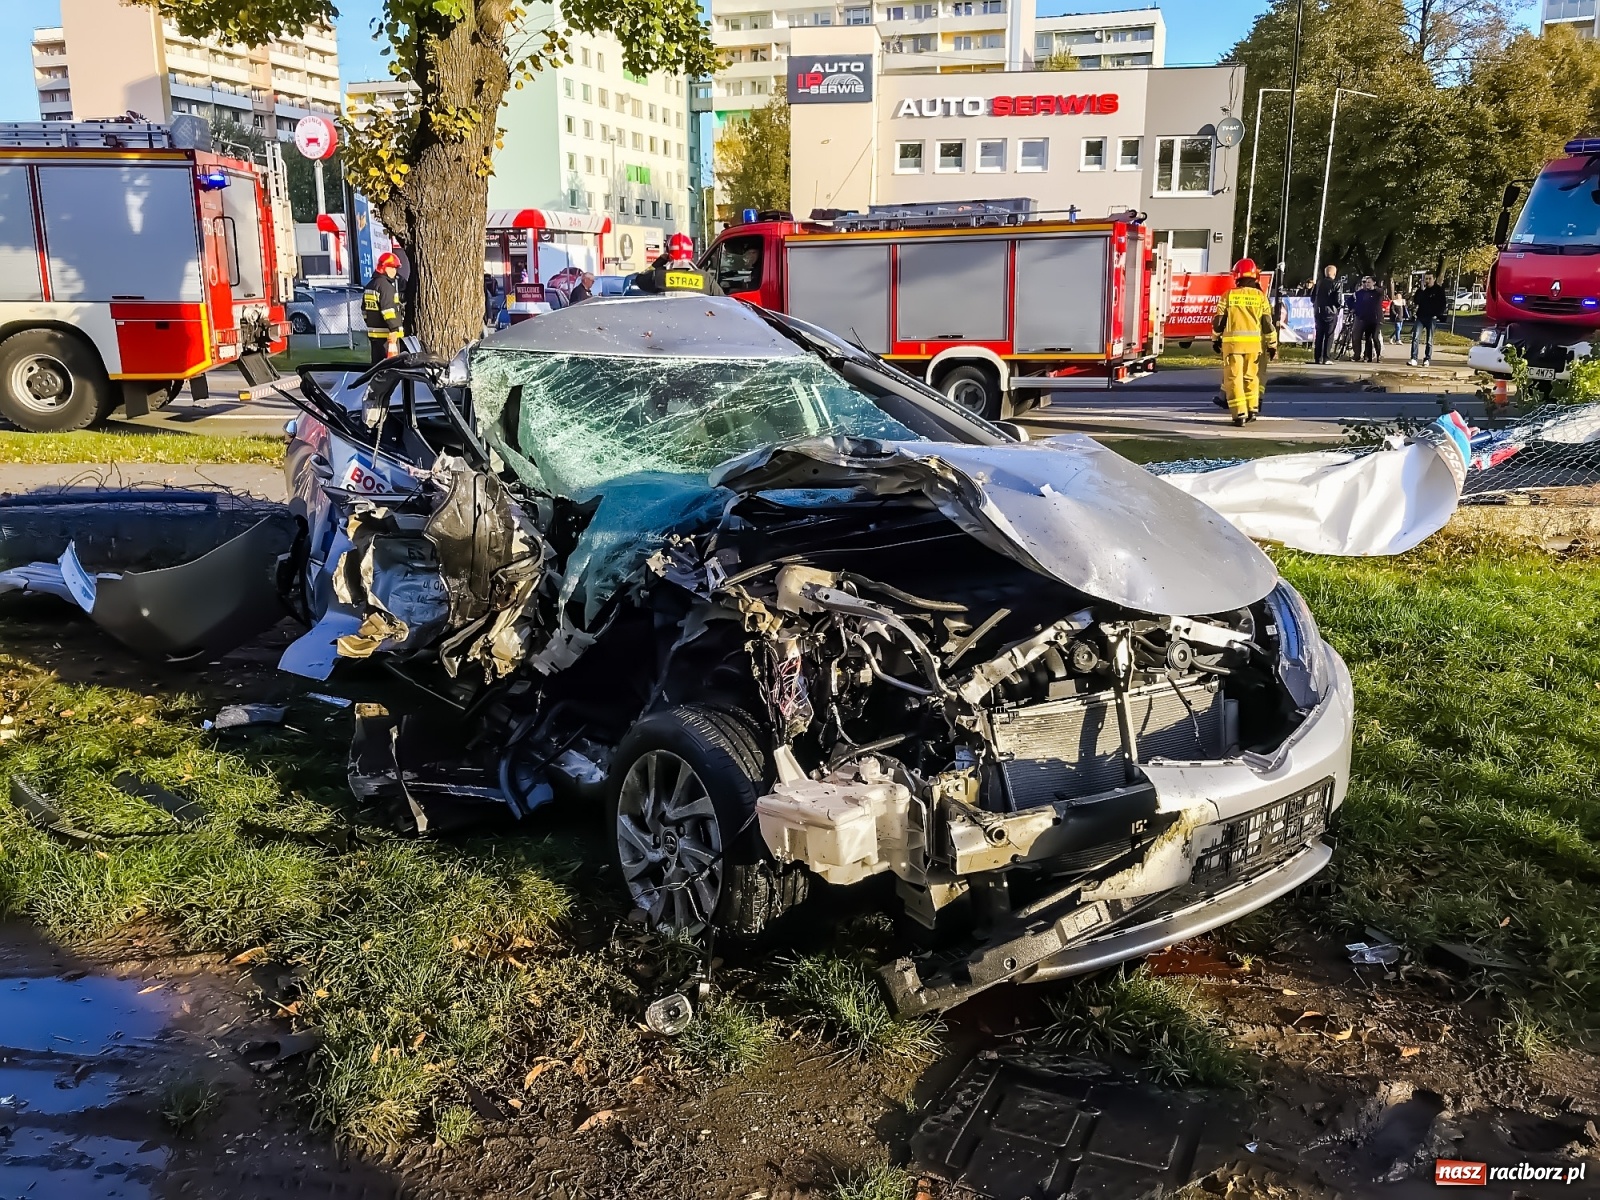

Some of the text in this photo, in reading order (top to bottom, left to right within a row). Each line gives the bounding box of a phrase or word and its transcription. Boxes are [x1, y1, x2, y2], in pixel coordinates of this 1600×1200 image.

[811, 62, 865, 73] AUTO
[797, 73, 823, 88] IP
[810, 84, 865, 94] SERWIS
[897, 94, 1119, 117] AUTO SERWIS
[350, 466, 393, 493] BOS
